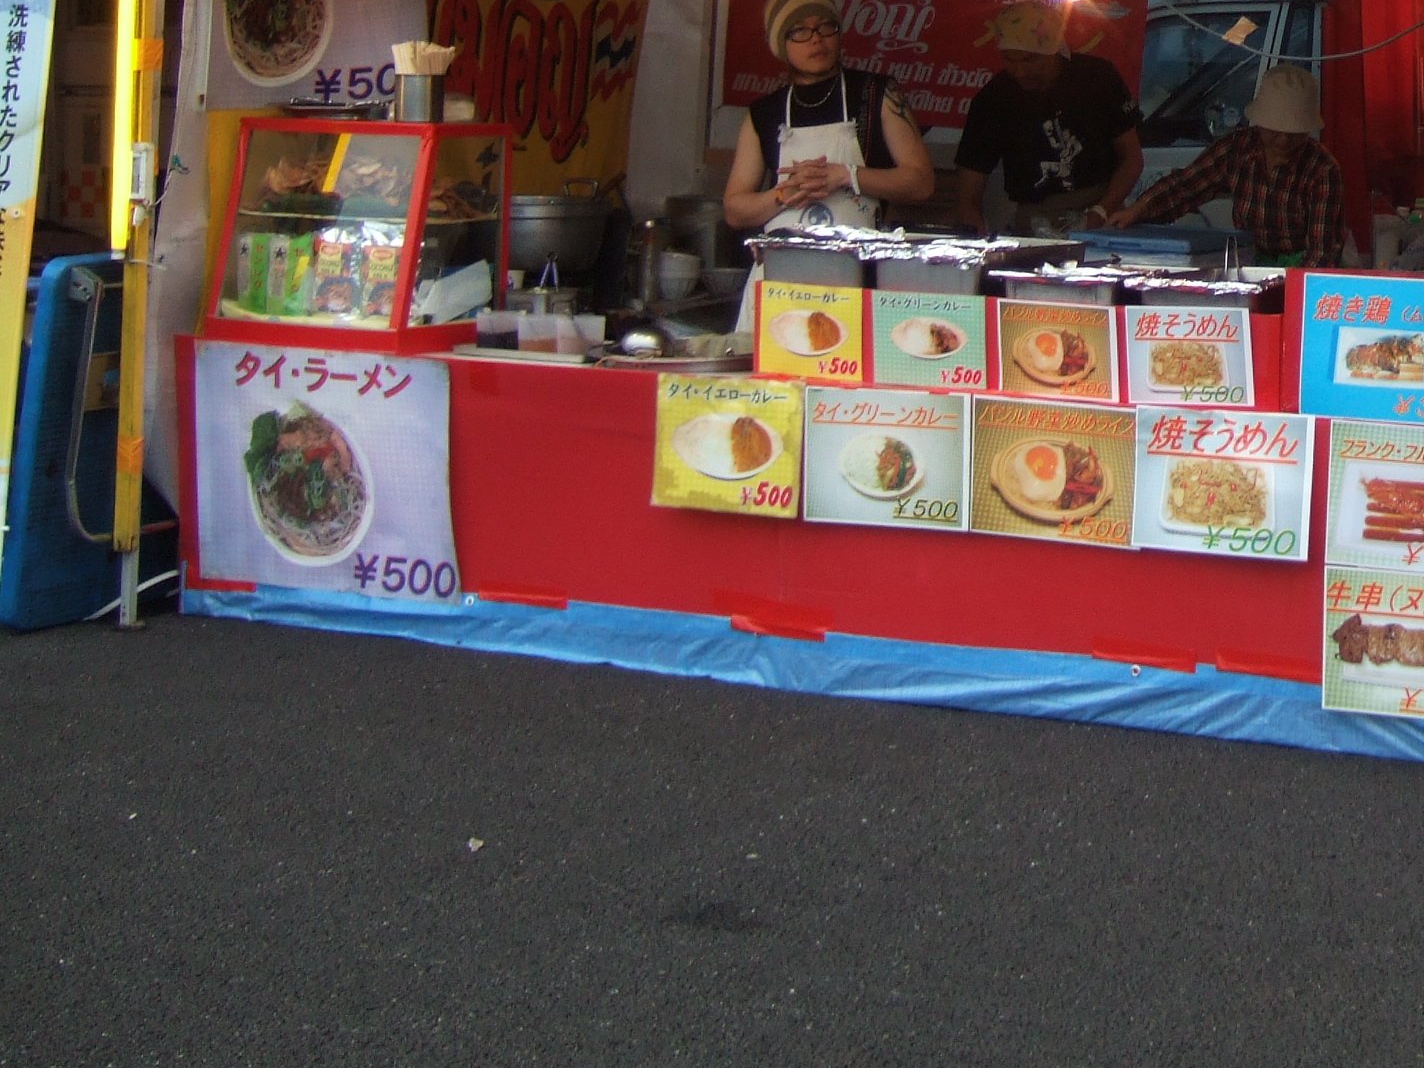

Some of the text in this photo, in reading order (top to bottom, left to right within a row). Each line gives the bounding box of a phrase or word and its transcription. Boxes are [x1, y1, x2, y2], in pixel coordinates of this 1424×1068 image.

[314, 63, 395, 100] ¥50
[1313, 292, 1393, 325] 焼き鶏
[235, 351, 413, 399] タイ・ラーメン
[818, 356, 859, 375] ¥500
[940, 365, 983, 385] ¥500
[1182, 385, 1244, 403] ¥500
[1147, 414, 1299, 459] 焼そうめん
[741, 481, 794, 509] ¥500
[893, 497, 958, 520] ¥500
[1058, 515, 1128, 541] ¥500
[1202, 524, 1297, 556] ¥500
[354, 552, 457, 598] ¥500
